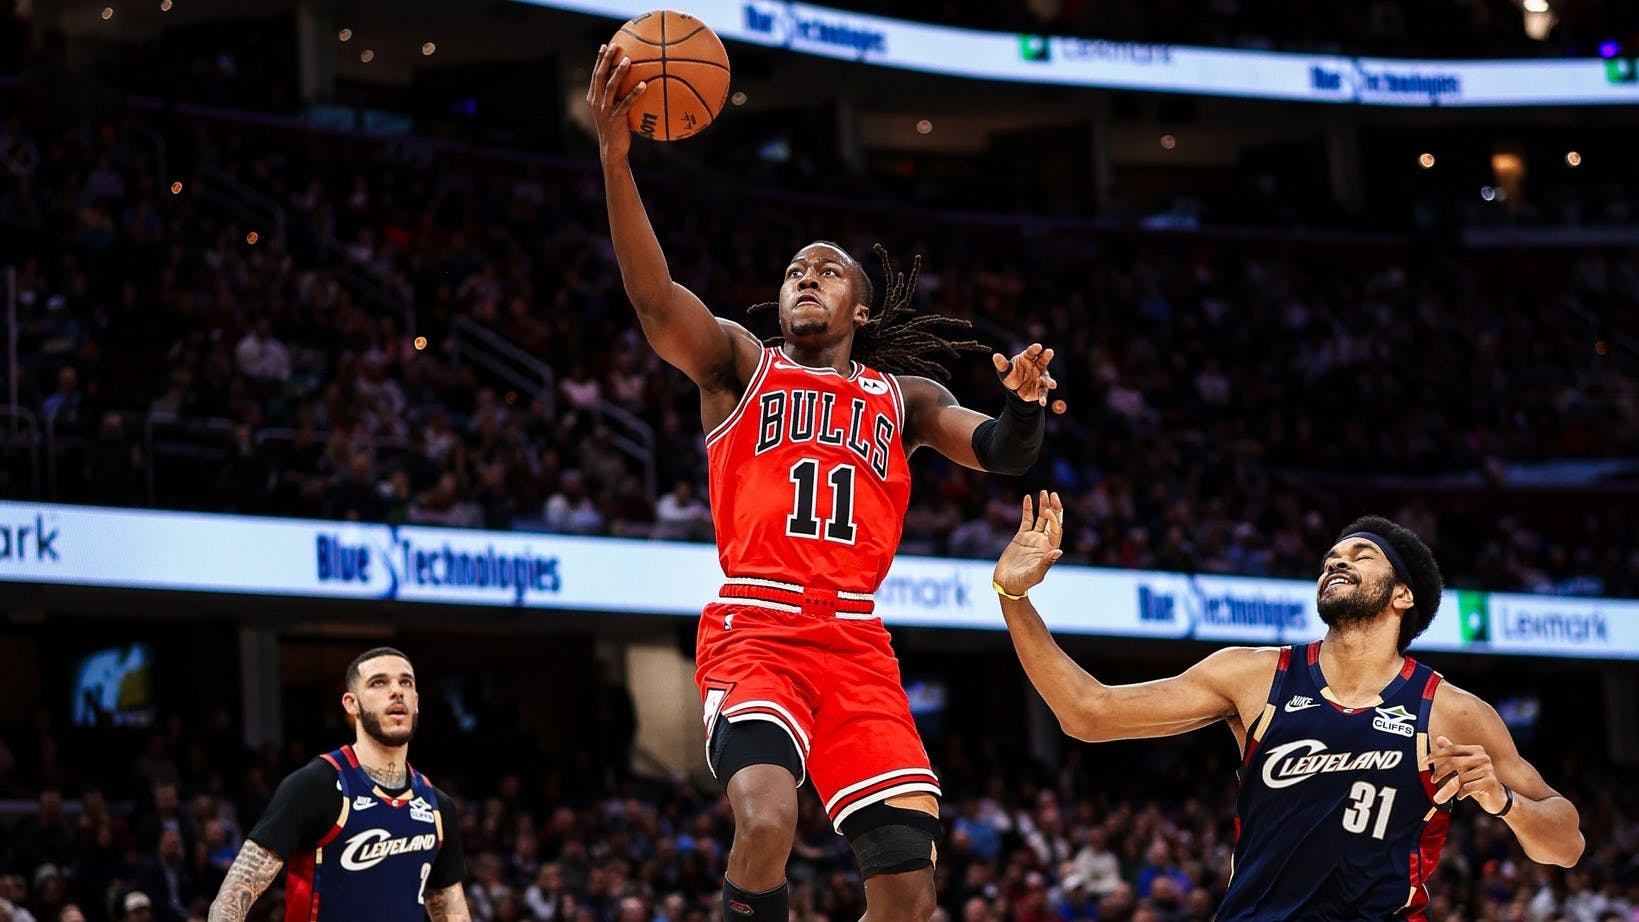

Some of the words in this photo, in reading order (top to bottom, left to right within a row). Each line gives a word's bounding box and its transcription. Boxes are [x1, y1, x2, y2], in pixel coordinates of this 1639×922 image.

[755, 389, 894, 481] BULLS
[785, 458, 857, 545] 11
[316, 534, 370, 582] Blue
[402, 538, 561, 606] Technologies
[1289, 695, 1314, 707] NIKE
[1374, 719, 1413, 735] CLIFFS
[1341, 781, 1398, 840] 31
[418, 862, 431, 905] 2
